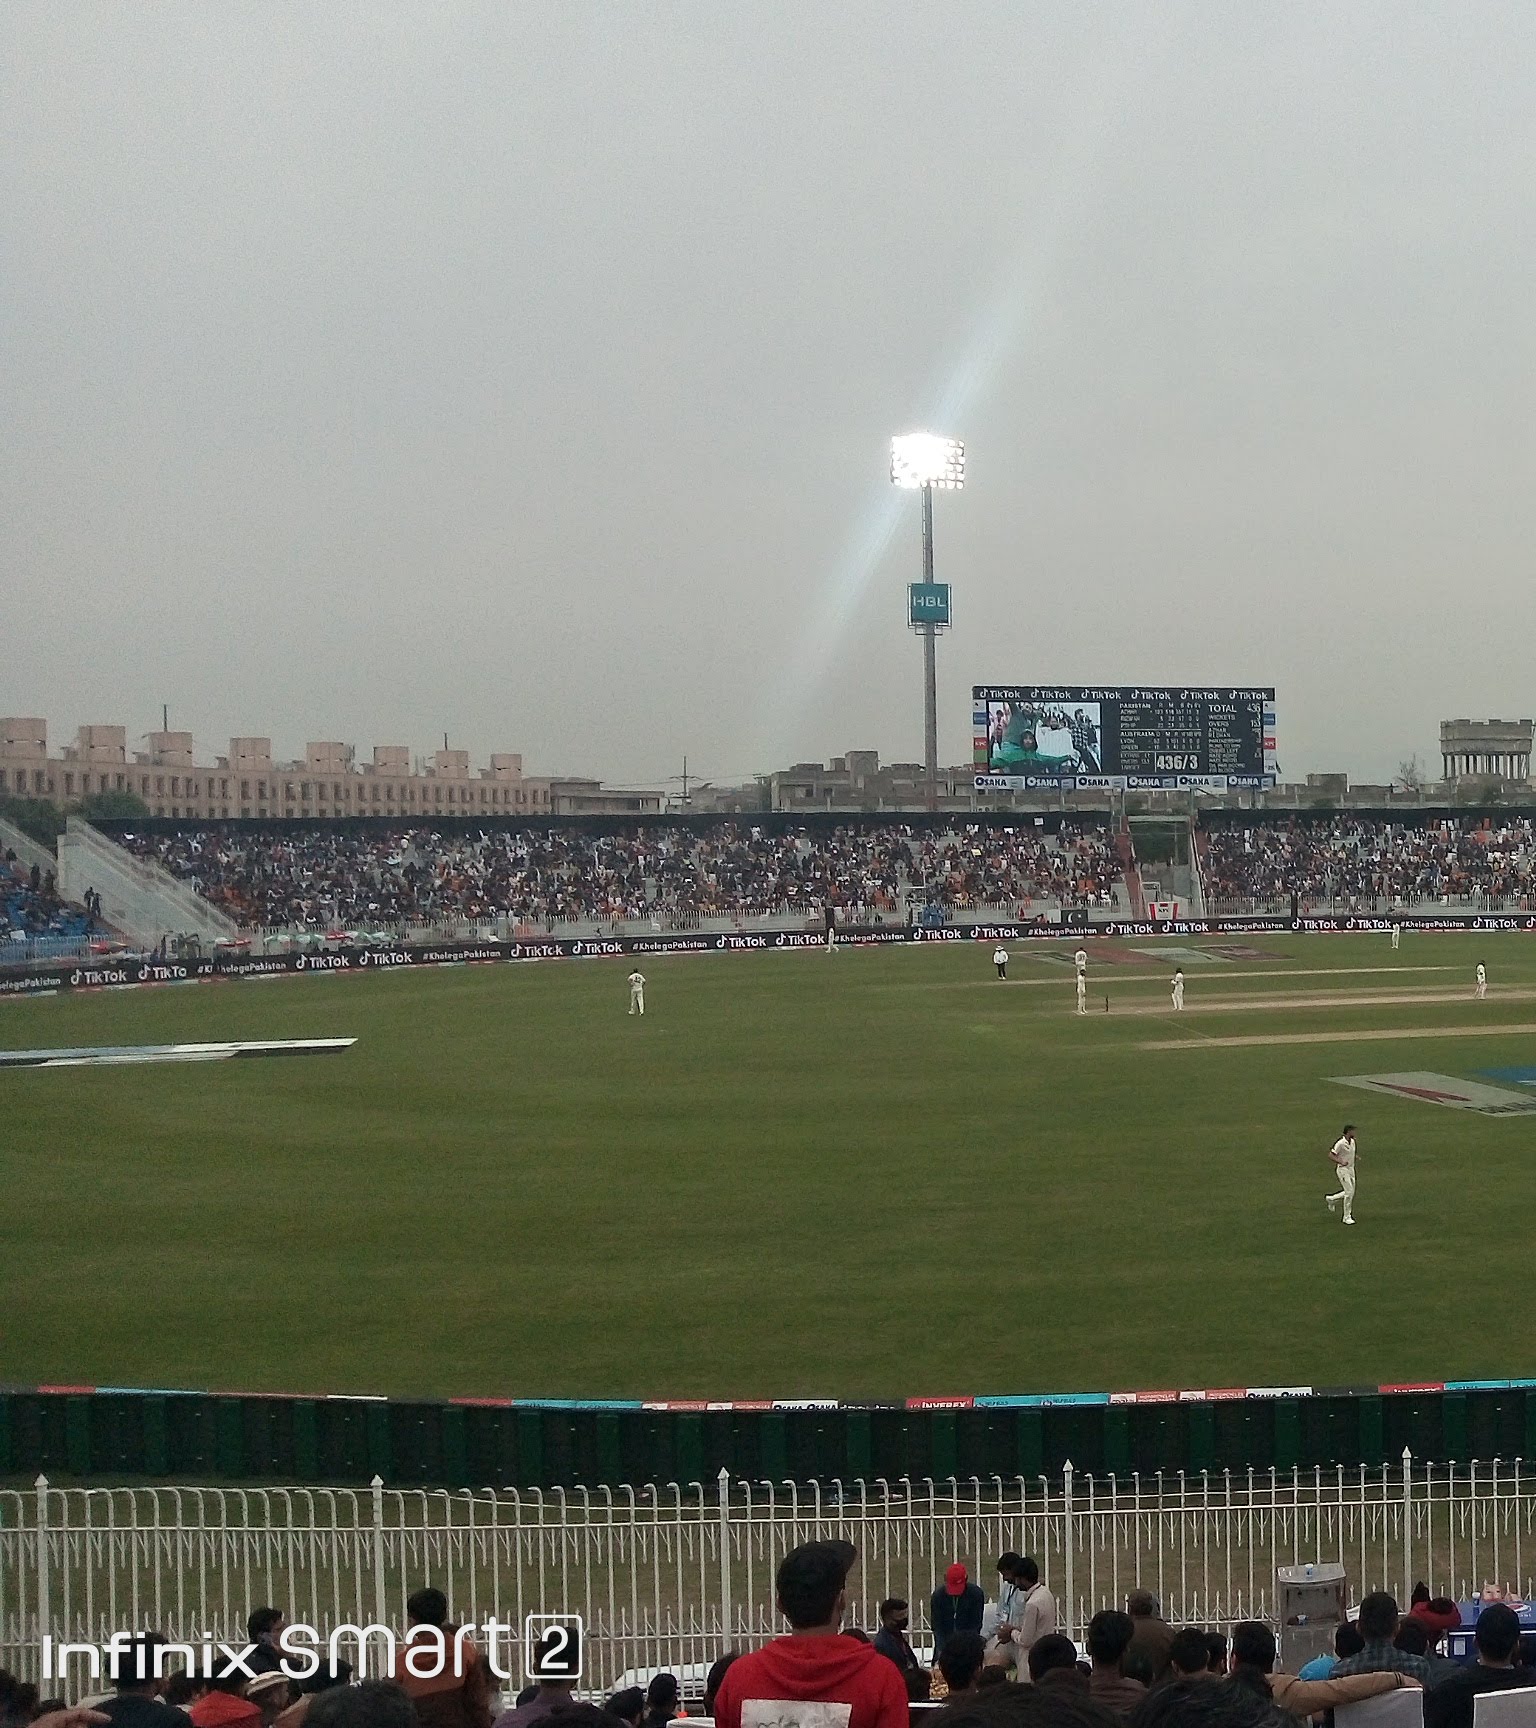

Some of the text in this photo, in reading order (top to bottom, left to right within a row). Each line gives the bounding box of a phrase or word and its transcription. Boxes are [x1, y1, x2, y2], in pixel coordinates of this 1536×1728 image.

[913, 595, 946, 608] HBL
[990, 690, 1268, 700] TikTok TikTok TikTok TikTok TikTok TikTok
[1208, 704, 1237, 713] TOTAL
[1157, 754, 1198, 770] 436/3
[975, 776, 1259, 787] OSAKA OSAKA OSAKA OSAKA OSAKA OSAKA
[310, 955, 350, 970] TikTok
[372, 951, 413, 965] TikTok
[585, 942, 623, 954] TikTok
[633, 941, 707, 951] #KhelegaPakistan
[728, 936, 767, 948] TikTok
[788, 934, 825, 945] TikTok
[925, 928, 962, 940] TikTok
[983, 927, 1019, 938] TikTok
[1028, 926, 1097, 937] #KhelegaPakistan
[1118, 923, 1153, 935] TikTok
[1174, 921, 1209, 933] TikTok
[1218, 922, 1284, 932] #KhelegaPakistan
[1303, 919, 1338, 930] TikTok
[1357, 919, 1392, 929] TikTok
[1484, 918, 1518, 929] TikTok
[85, 969, 127, 984] TikTok
